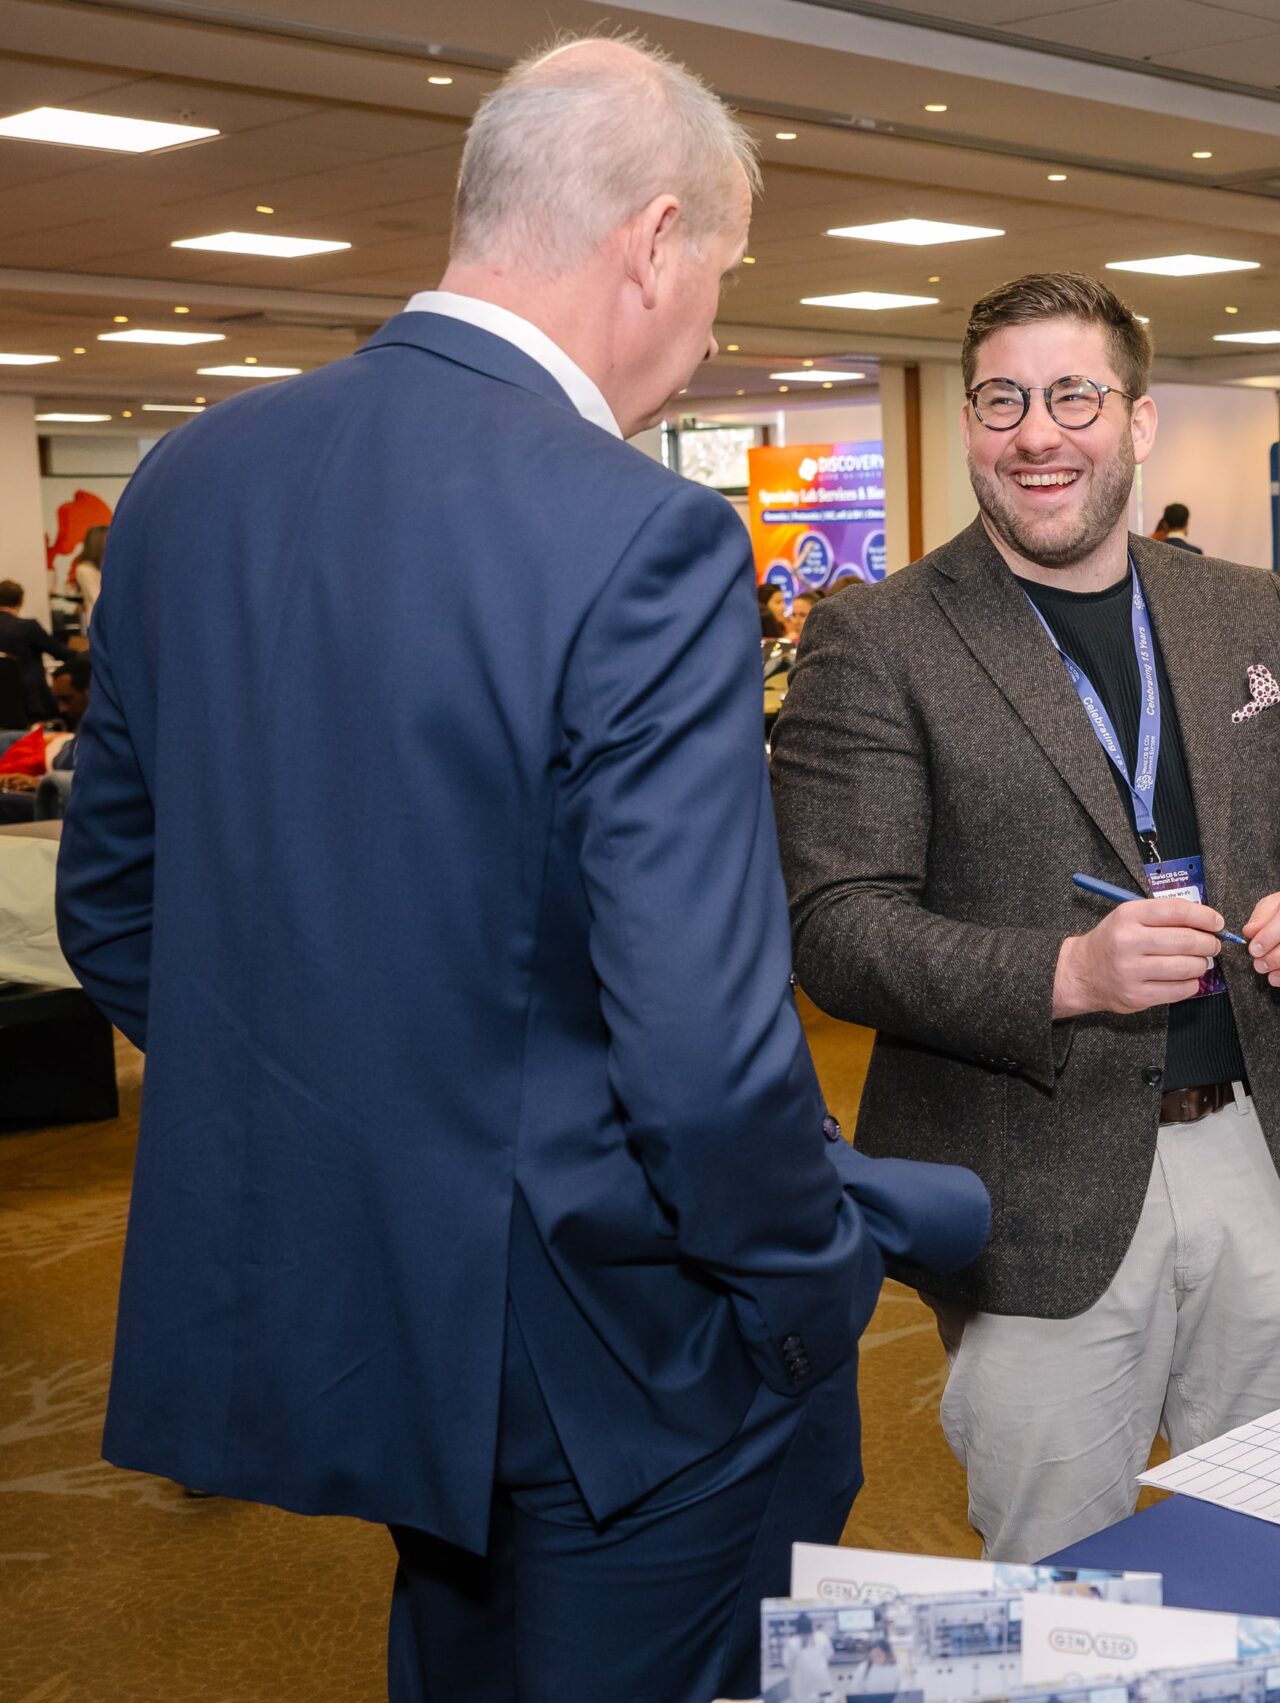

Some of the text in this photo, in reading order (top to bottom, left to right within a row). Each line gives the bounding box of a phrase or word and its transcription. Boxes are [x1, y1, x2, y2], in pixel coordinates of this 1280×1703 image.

[1138, 626, 1155, 716] Celebrating 15 Years
[1082, 696, 1117, 753] Celebrating
[823, 1583, 854, 1600] GEN
[1053, 1634, 1131, 1655] GEN SEQ
